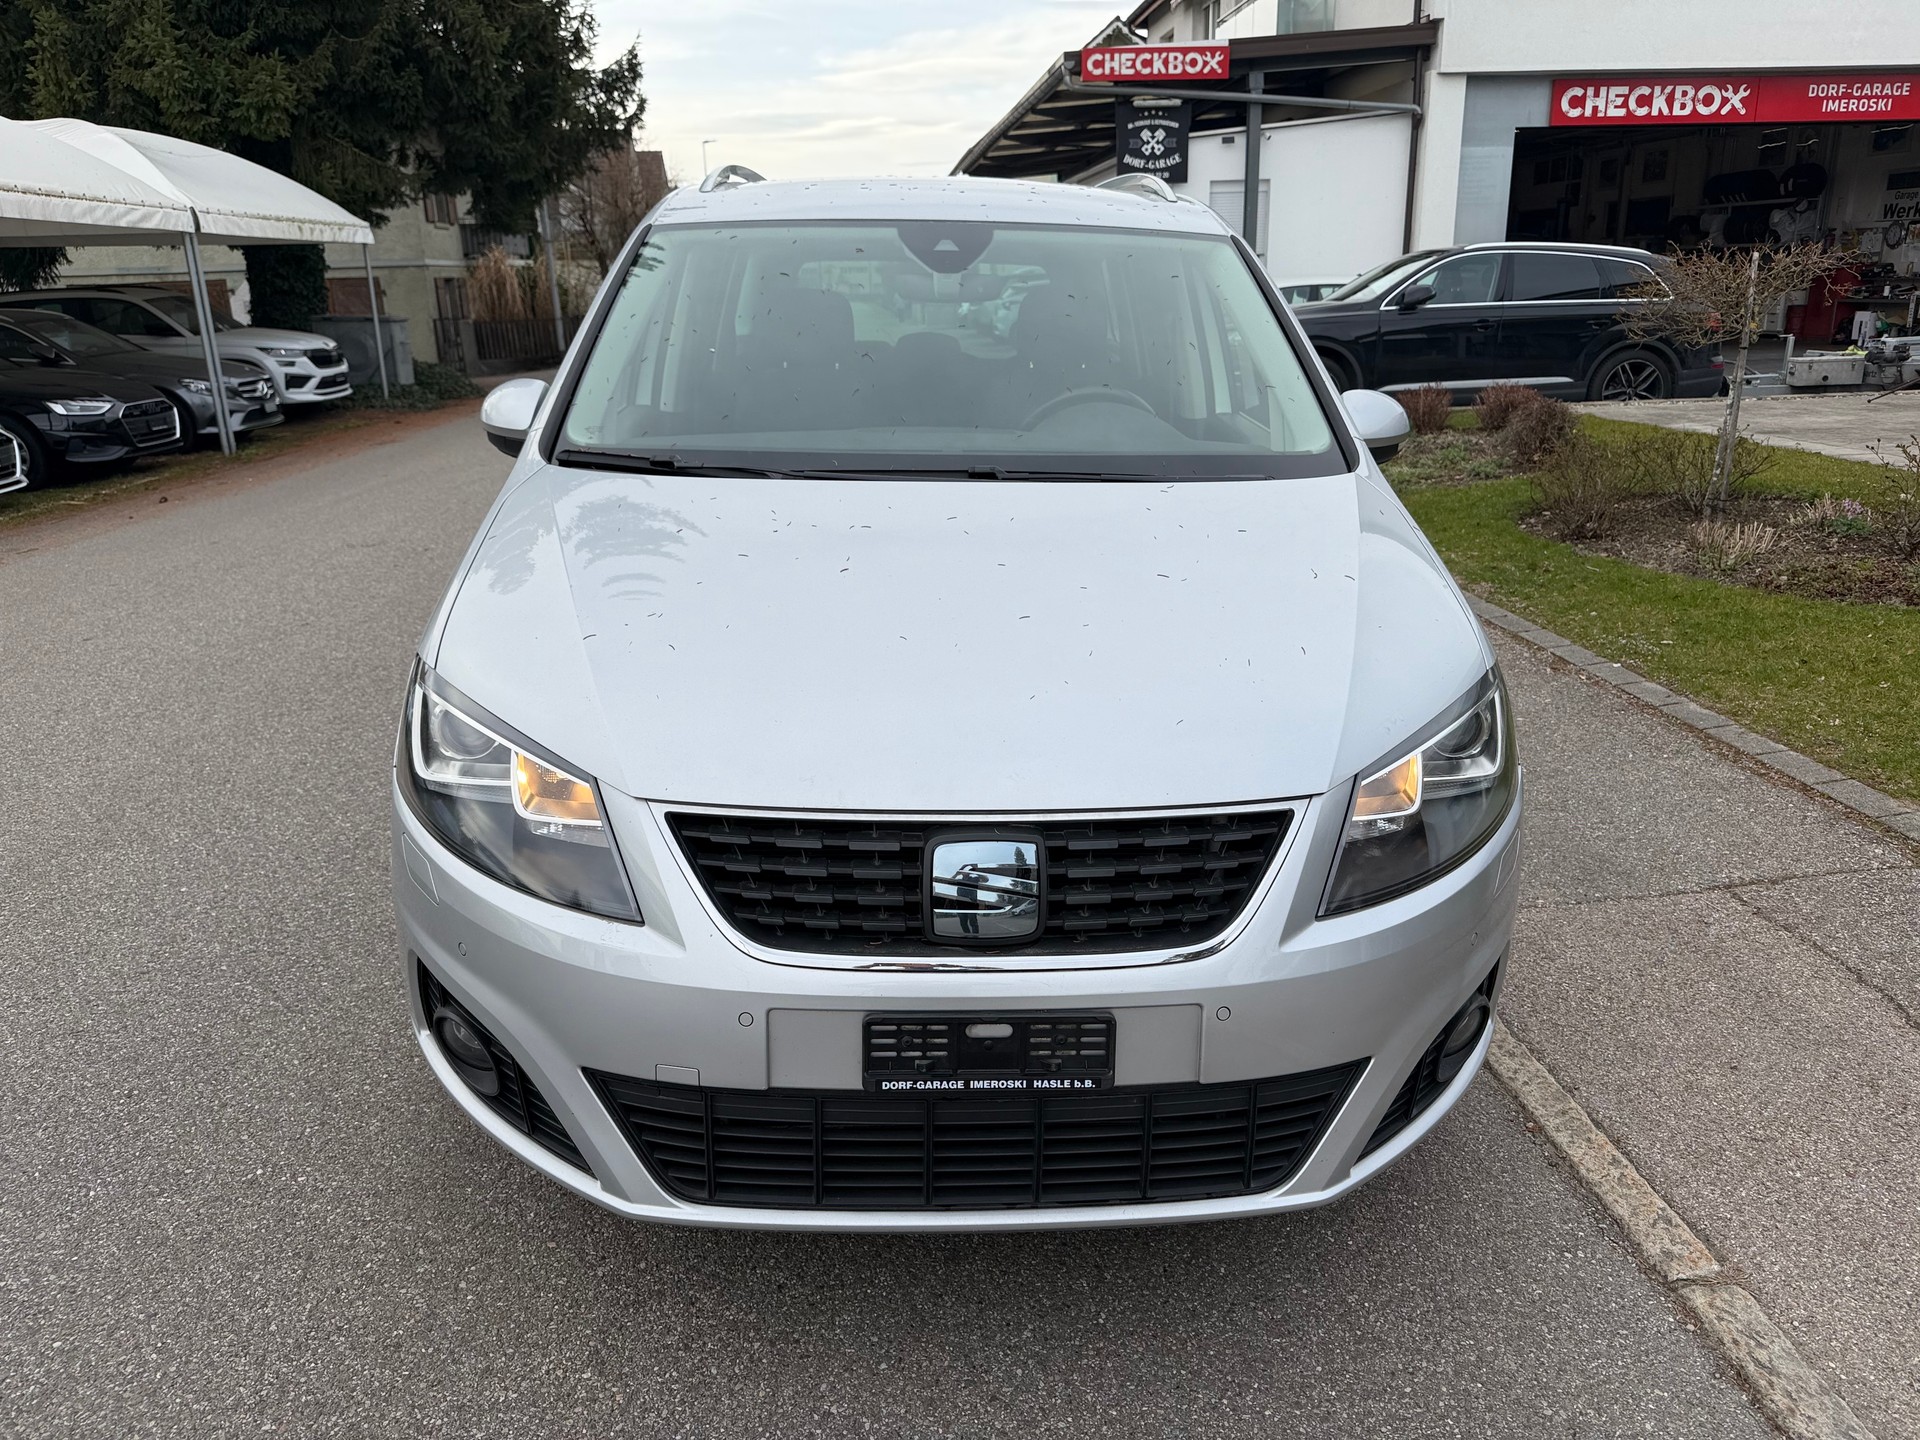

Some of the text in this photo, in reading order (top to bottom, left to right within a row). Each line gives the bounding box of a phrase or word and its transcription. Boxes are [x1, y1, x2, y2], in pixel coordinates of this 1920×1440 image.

[1086, 51, 1224, 76] CHECKBOX
[1808, 83, 1911, 97] DORF-GARAGE
[1561, 84, 1751, 118] CHECKBOX
[1822, 98, 1892, 112] IMEROSKI
[1122, 152, 1182, 170] DORF-GARAGE
[1894, 190, 1919, 201] Garage
[881, 1079, 1096, 1090] DORF-GARAGE IMEROSKI HASLE b.B.
